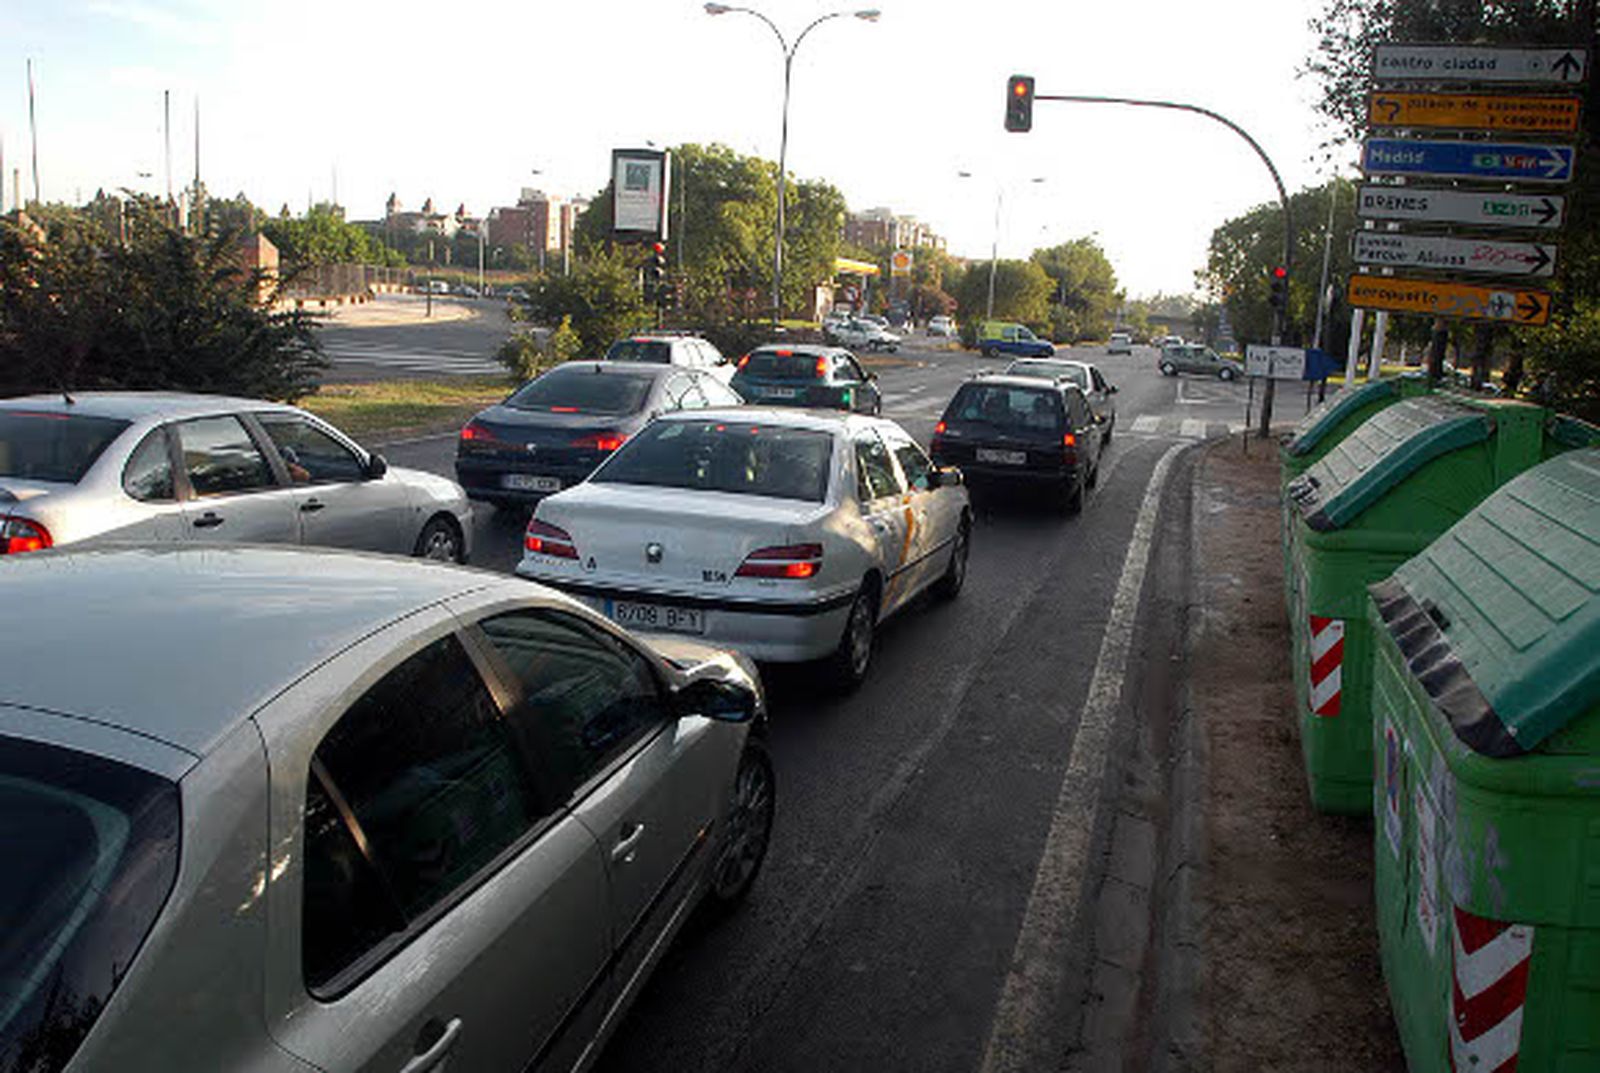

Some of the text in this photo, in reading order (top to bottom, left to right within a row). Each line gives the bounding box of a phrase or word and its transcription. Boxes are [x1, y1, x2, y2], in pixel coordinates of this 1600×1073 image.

[1443, 57, 1497, 70] ciudad
[1370, 150, 1424, 165] Madrid
[1363, 195, 1429, 212] BRENES
[1355, 285, 1439, 305] aeropuerto
